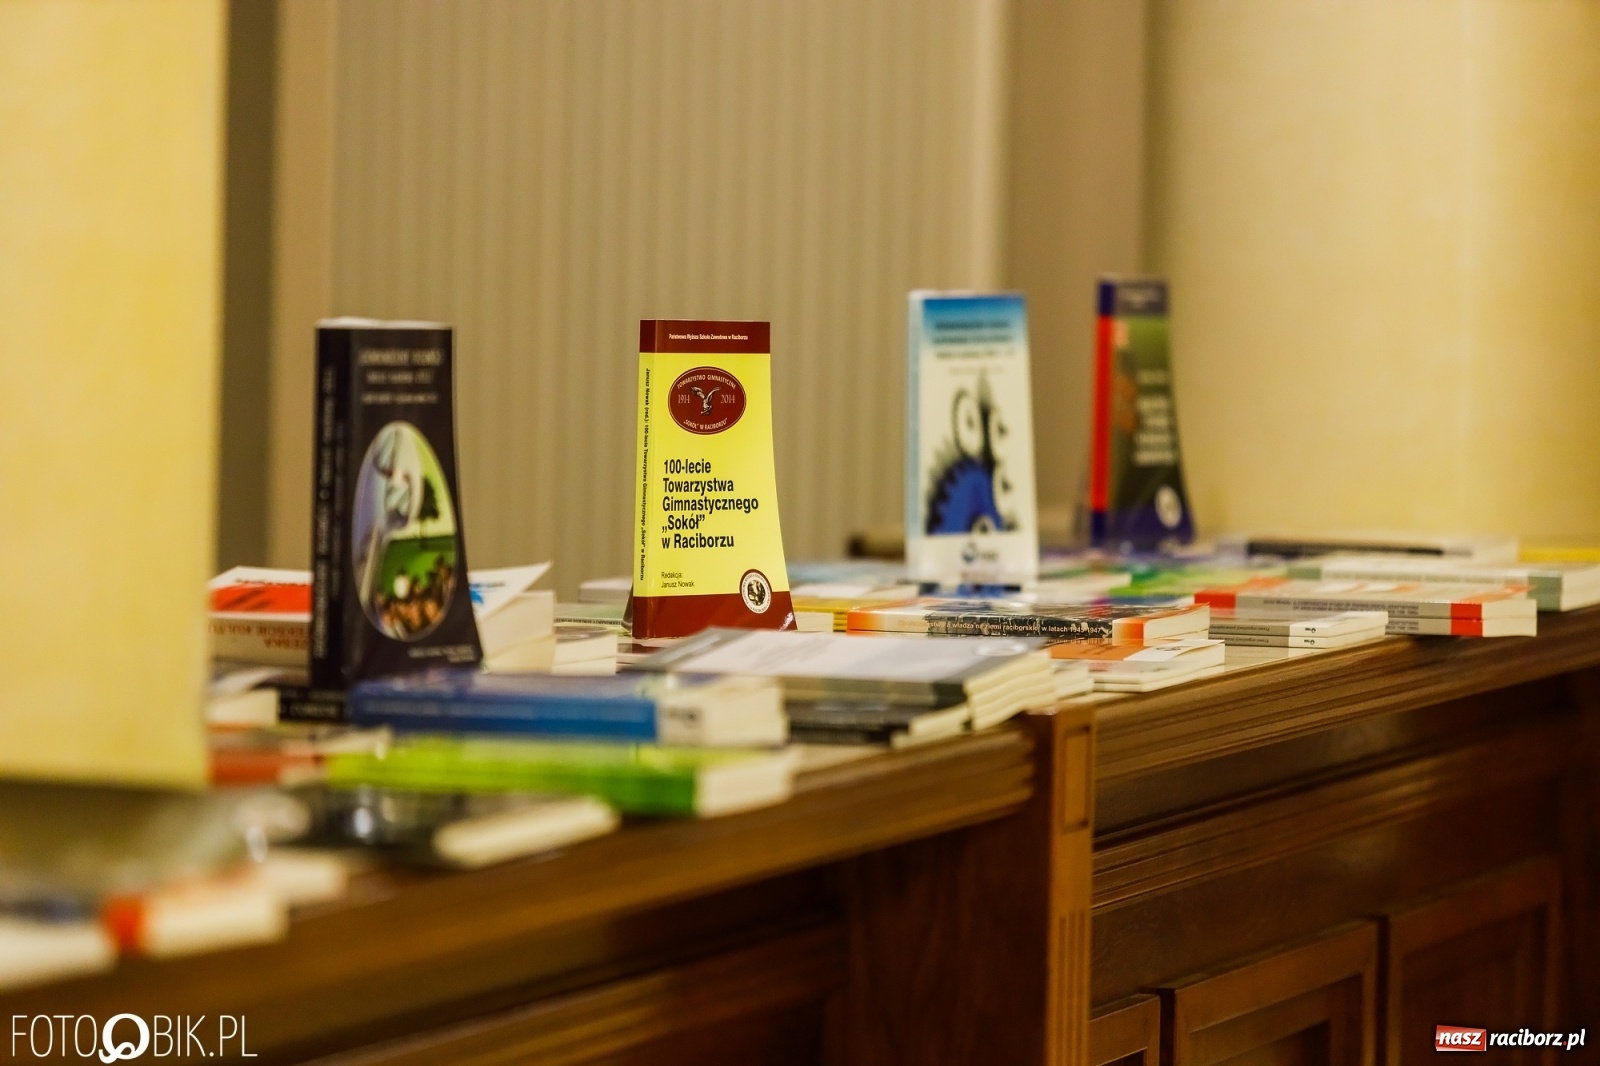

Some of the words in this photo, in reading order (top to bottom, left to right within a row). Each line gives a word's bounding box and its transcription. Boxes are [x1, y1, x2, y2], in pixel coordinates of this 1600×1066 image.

[678, 394, 690, 404] 1914
[720, 394, 735, 404] 2014
[664, 458, 712, 474] 100-lecie
[662, 478, 734, 496] Towarzystwa
[662, 496, 759, 514] Gimnastycznego
[662, 537, 670, 548] w
[674, 533, 734, 548] Raciborzu
[661, 572, 682, 580] Redakcja:
